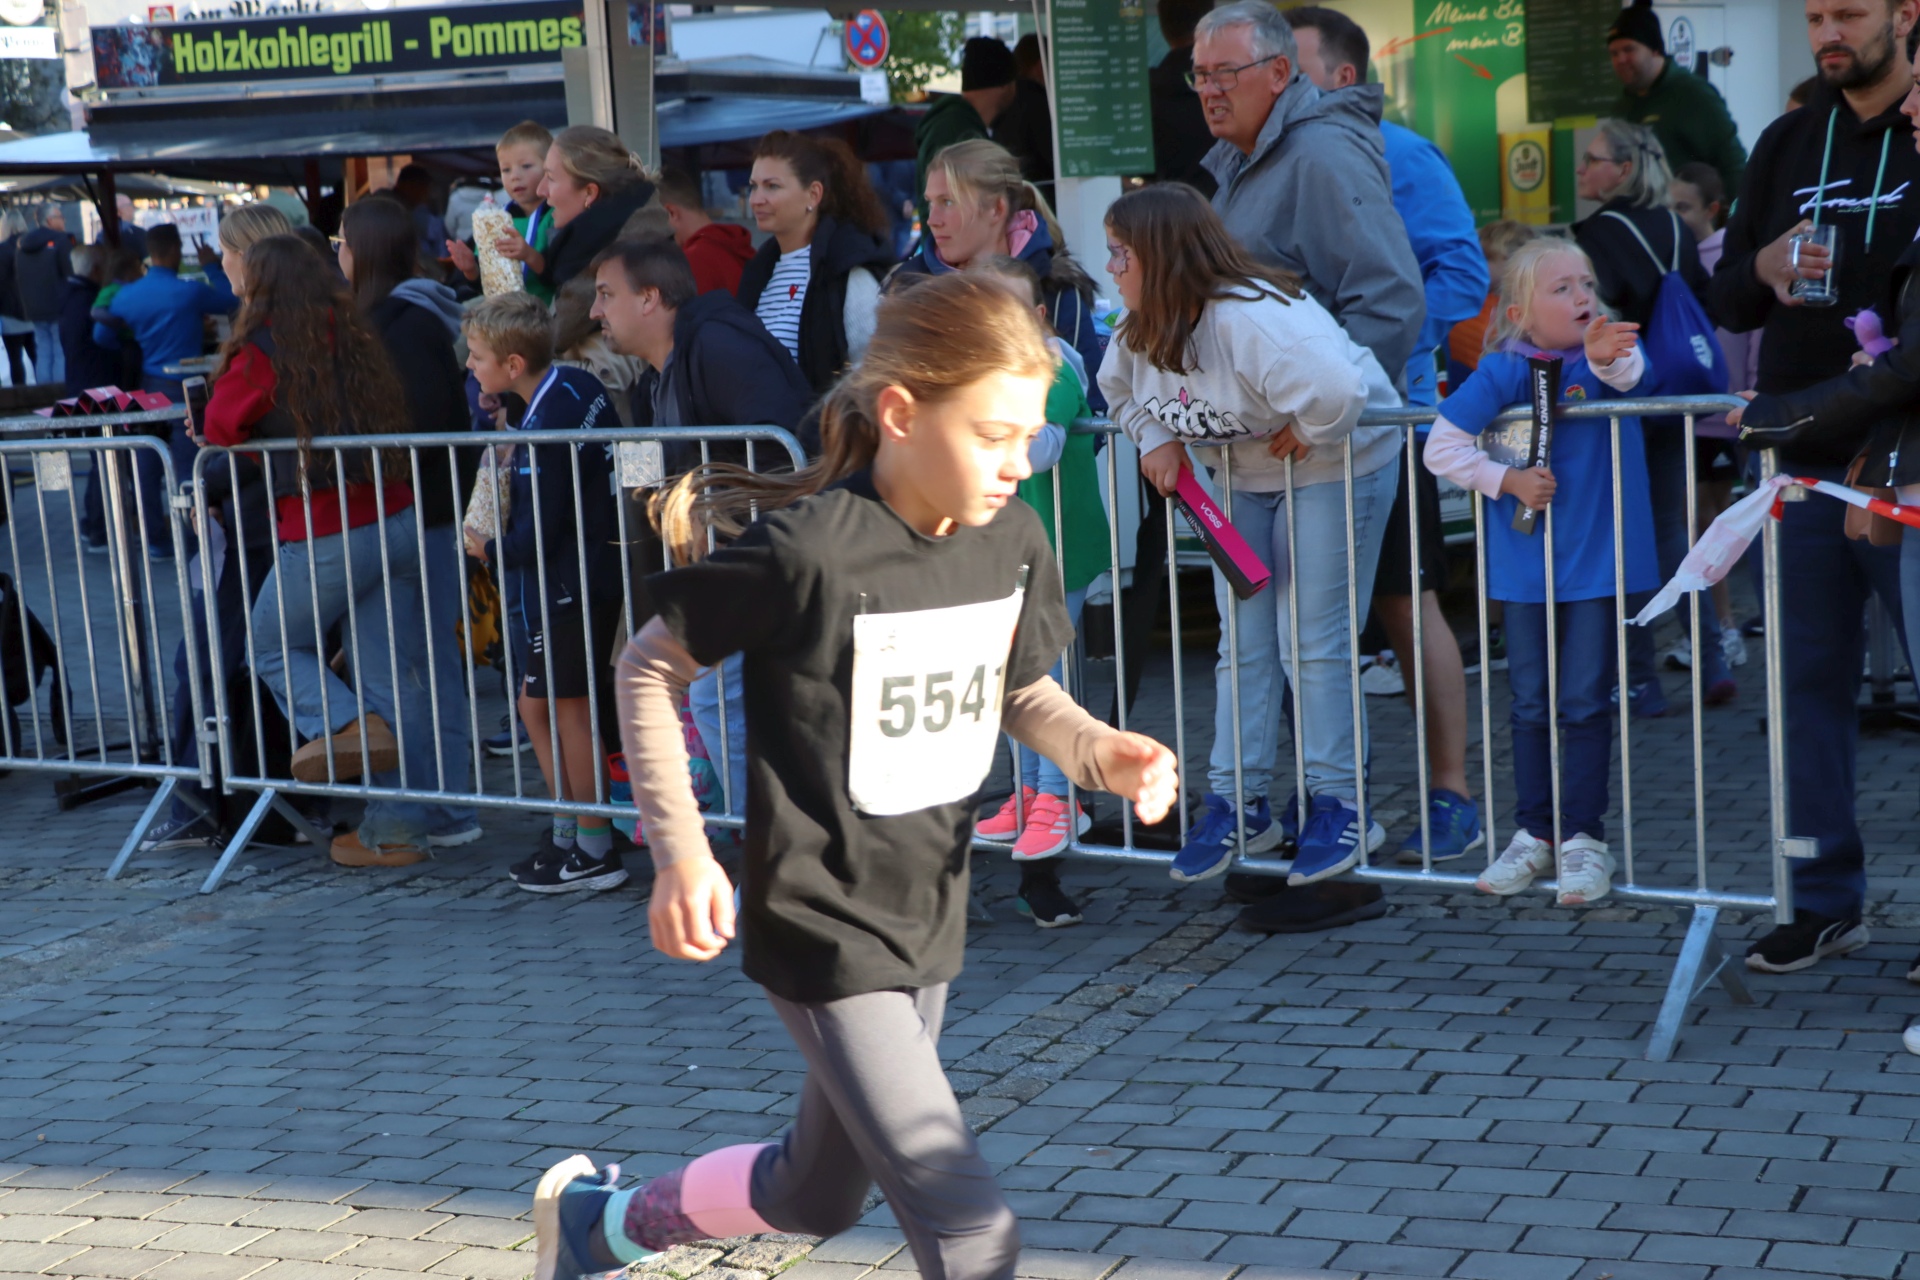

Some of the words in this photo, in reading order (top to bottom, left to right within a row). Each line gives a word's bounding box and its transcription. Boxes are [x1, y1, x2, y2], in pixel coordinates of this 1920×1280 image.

[1425, 1, 1488, 26] Meine
[172, 20, 393, 74] Holzkohlegrill
[429, 16, 583, 59] Pommes
[1445, 32, 1499, 52] mein
[1537, 369, 1549, 424] LAUFEND
[1536, 425, 1550, 463] NEUE
[1200, 502, 1223, 529] VOSS
